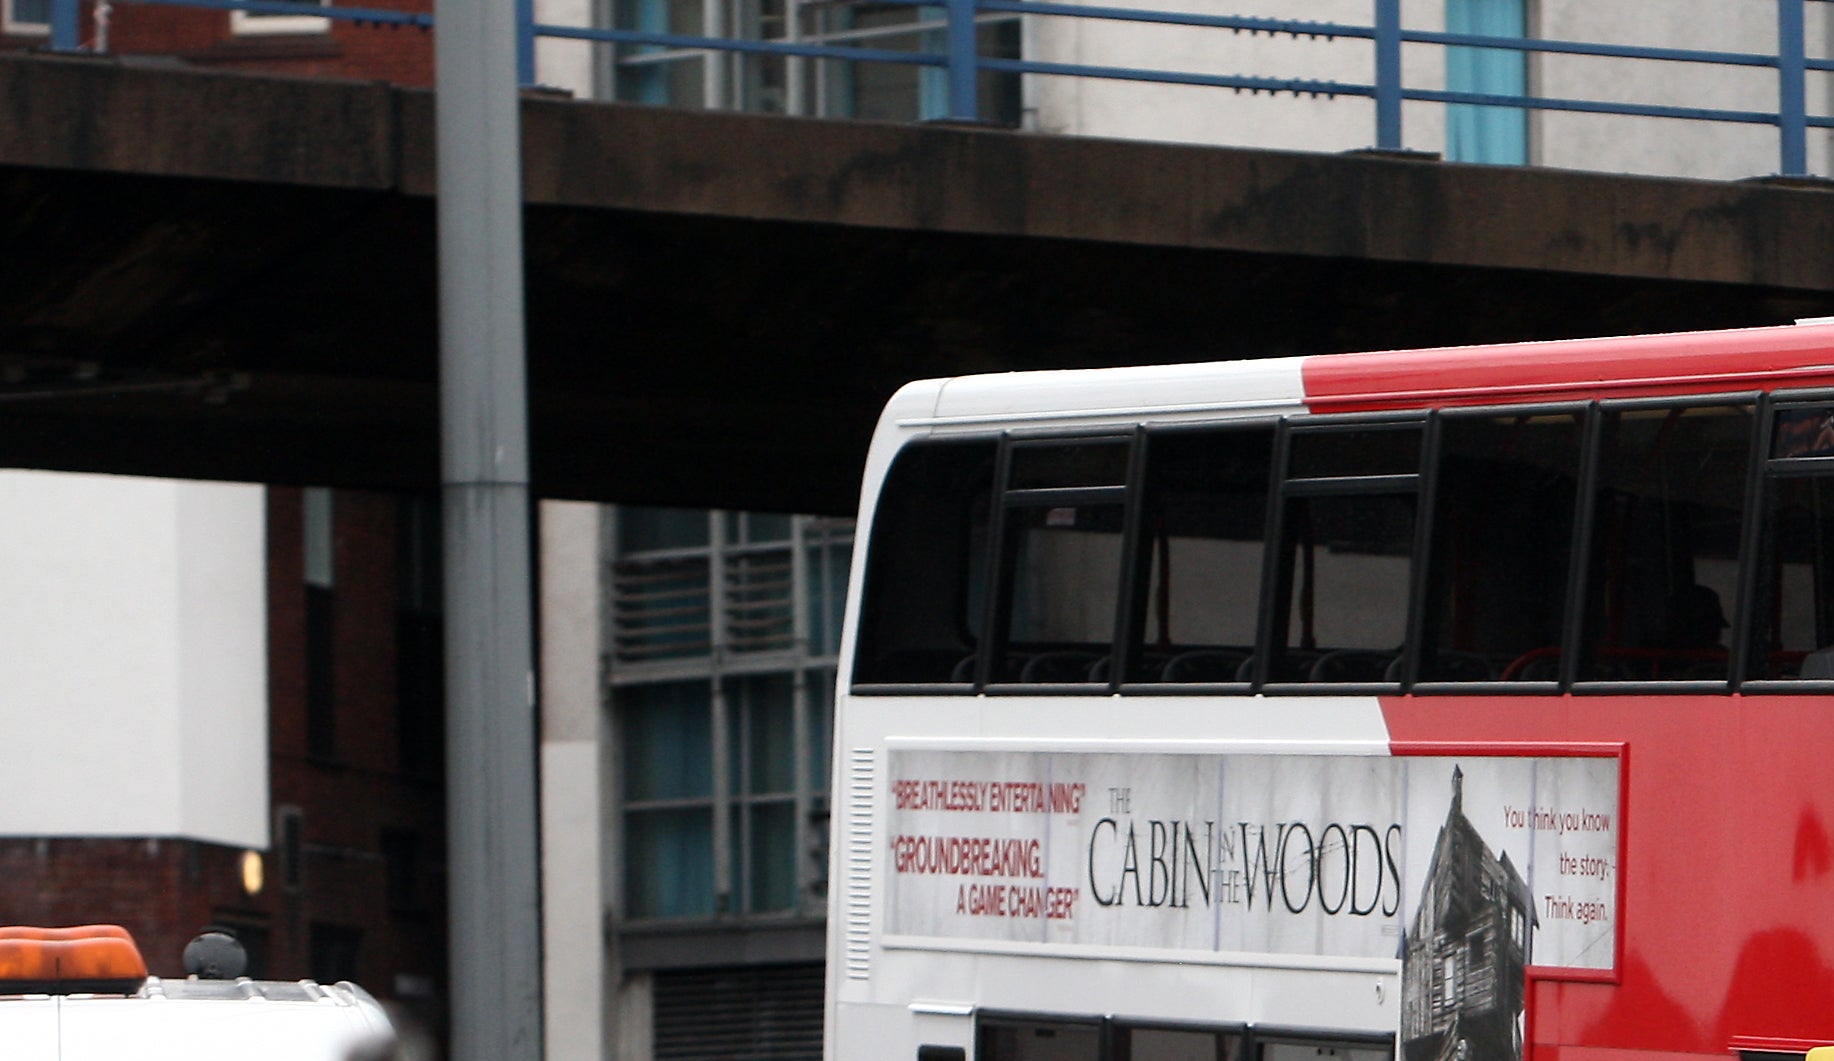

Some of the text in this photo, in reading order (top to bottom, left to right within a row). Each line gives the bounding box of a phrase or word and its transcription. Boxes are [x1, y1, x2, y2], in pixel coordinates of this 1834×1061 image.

[990, 782, 1086, 815] ENTERTANING"
[1108, 787, 1132, 815] THE
[1504, 805, 1525, 829] You
[1559, 813, 1579, 836] you
[1582, 807, 1611, 832] know
[1088, 817, 1214, 909] CABIN
[1210, 867, 1240, 904] THE
[1237, 820, 1402, 918] WOODS
[1560, 851, 1578, 876] the
[956, 884, 966, 916] A
[969, 884, 1006, 917] GAME
[1545, 895, 1608, 926] Think again.
